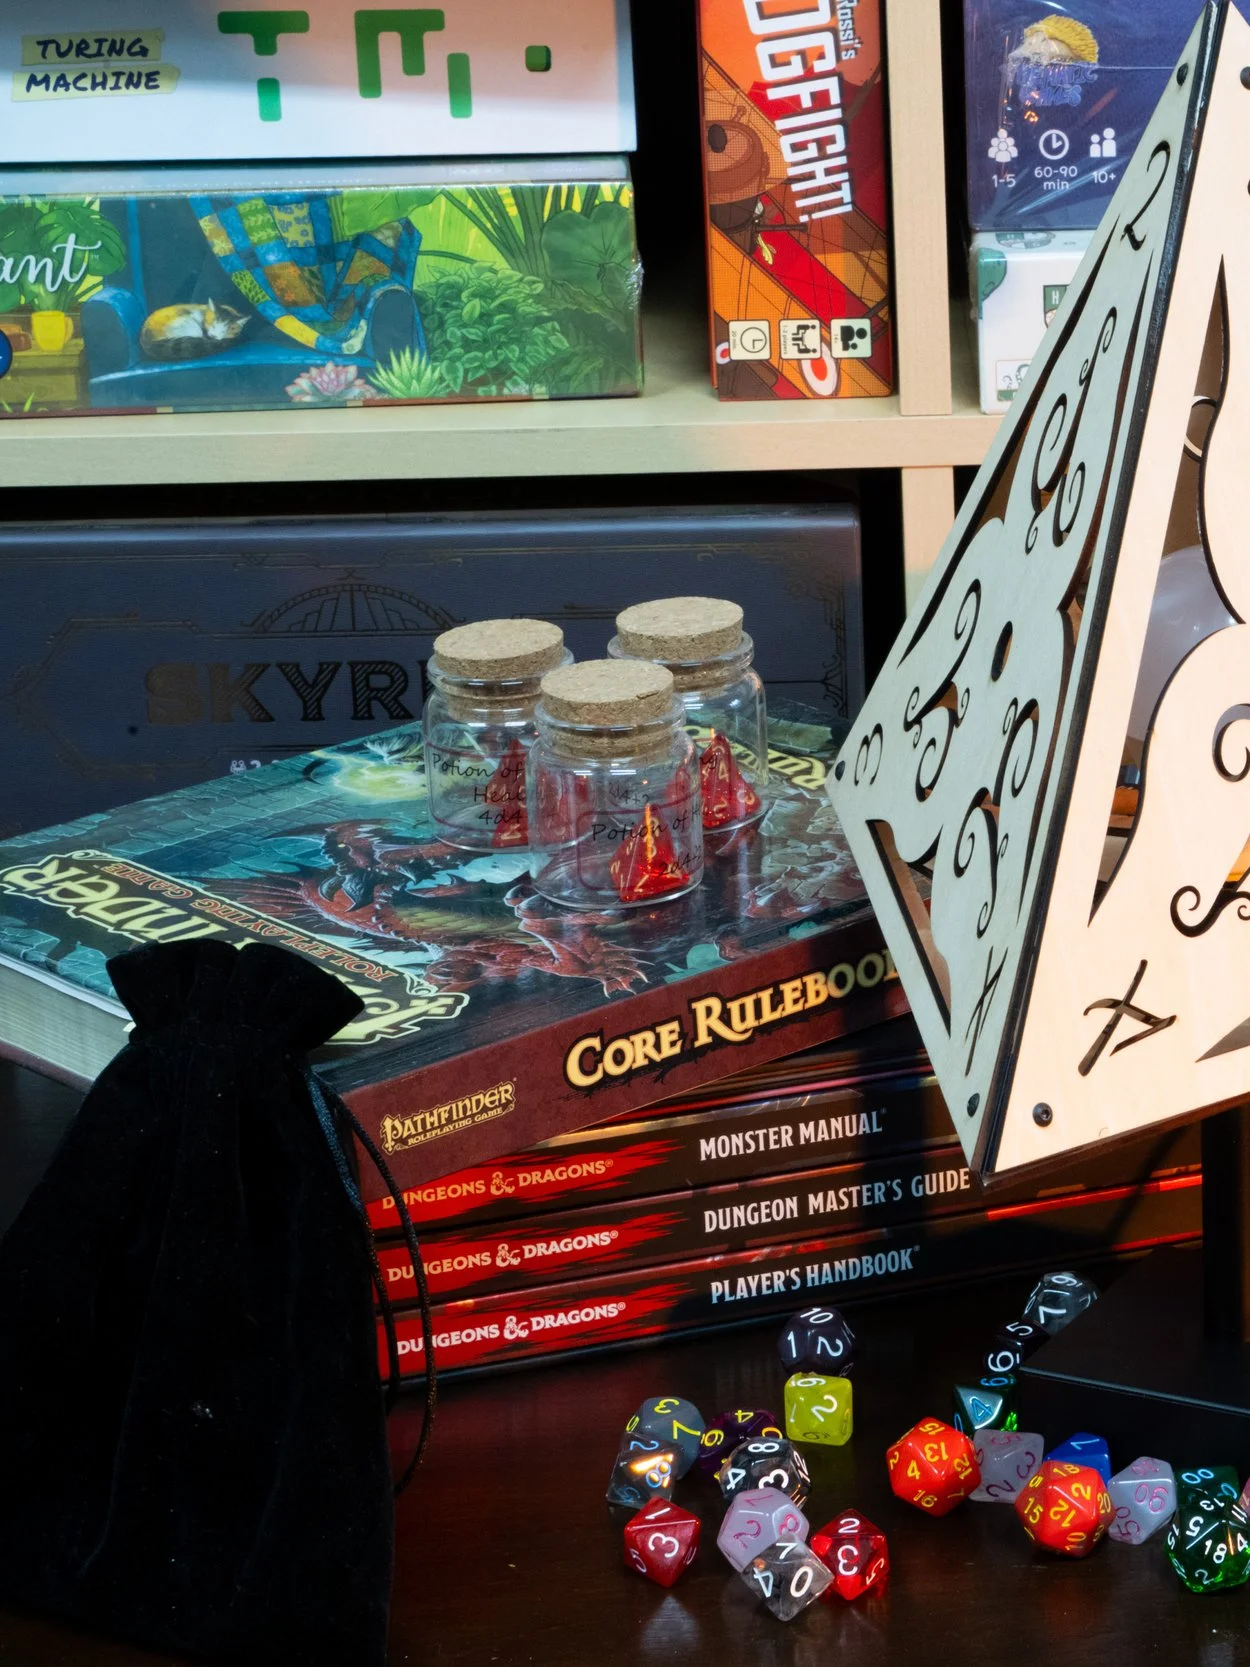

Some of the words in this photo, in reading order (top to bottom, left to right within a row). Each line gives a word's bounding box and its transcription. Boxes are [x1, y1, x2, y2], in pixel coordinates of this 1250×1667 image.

[36, 37, 149, 60] TURING
[25, 70, 161, 93] MACHINE
[992, 174, 1016, 188] 1-5
[1034, 166, 1078, 178] 60-90
[1092, 171, 1116, 183] 10+
[1044, 179, 1070, 190] min
[1121, 140, 1170, 250] 2
[432, 753, 495, 777] Potion
[592, 823, 667, 841] Potion
[673, 811, 689, 831] of
[101, 861, 194, 901] GAME
[191, 897, 399, 982] ROLEPLAYING
[565, 1019, 683, 1087] CORE
[381, 1081, 515, 1153] PATHFINDER
[408, 1118, 472, 1146] ROLEPLAYING
[475, 1107, 503, 1122] GAME
[699, 1125, 793, 1161] MONSTER
[704, 1195, 798, 1232] DUNGEON
[808, 1178, 903, 1215] MASTER'S
[911, 1167, 971, 1198] GUIDE
[711, 1267, 800, 1304] PLAYER'S
[800, 1307, 833, 1324] 10
[1039, 1305, 1066, 1324] 7
[1006, 1322, 1033, 1336] 5
[788, 1331, 797, 1358] 1
[817, 1336, 844, 1357] 2
[654, 1398, 679, 1414] 3
[735, 1409, 754, 1423] 4
[811, 1395, 838, 1422] 2
[970, 1396, 993, 1420] 4
[672, 1419, 701, 1440] 7
[748, 1442, 780, 1453] 8
[924, 1442, 949, 1462] 13
[726, 1468, 746, 1489] 4
[758, 1468, 789, 1489] 3
[906, 1460, 920, 1480] 4
[1071, 1482, 1092, 1500] 2
[1024, 1498, 1044, 1524] 15
[1097, 1492, 1111, 1514] 20
[838, 1518, 861, 1534] 2
[1050, 1502, 1077, 1528] 12
[1185, 1516, 1204, 1537] 5
[648, 1532, 679, 1558] 3
[733, 1519, 762, 1548] 2
[1236, 1533, 1248, 1552] 4
[775, 1542, 799, 1559] 7
[837, 1544, 859, 1576] 3
[1204, 1539, 1227, 1564] 18
[753, 1566, 774, 1598] 4
[789, 1566, 814, 1597] 0
